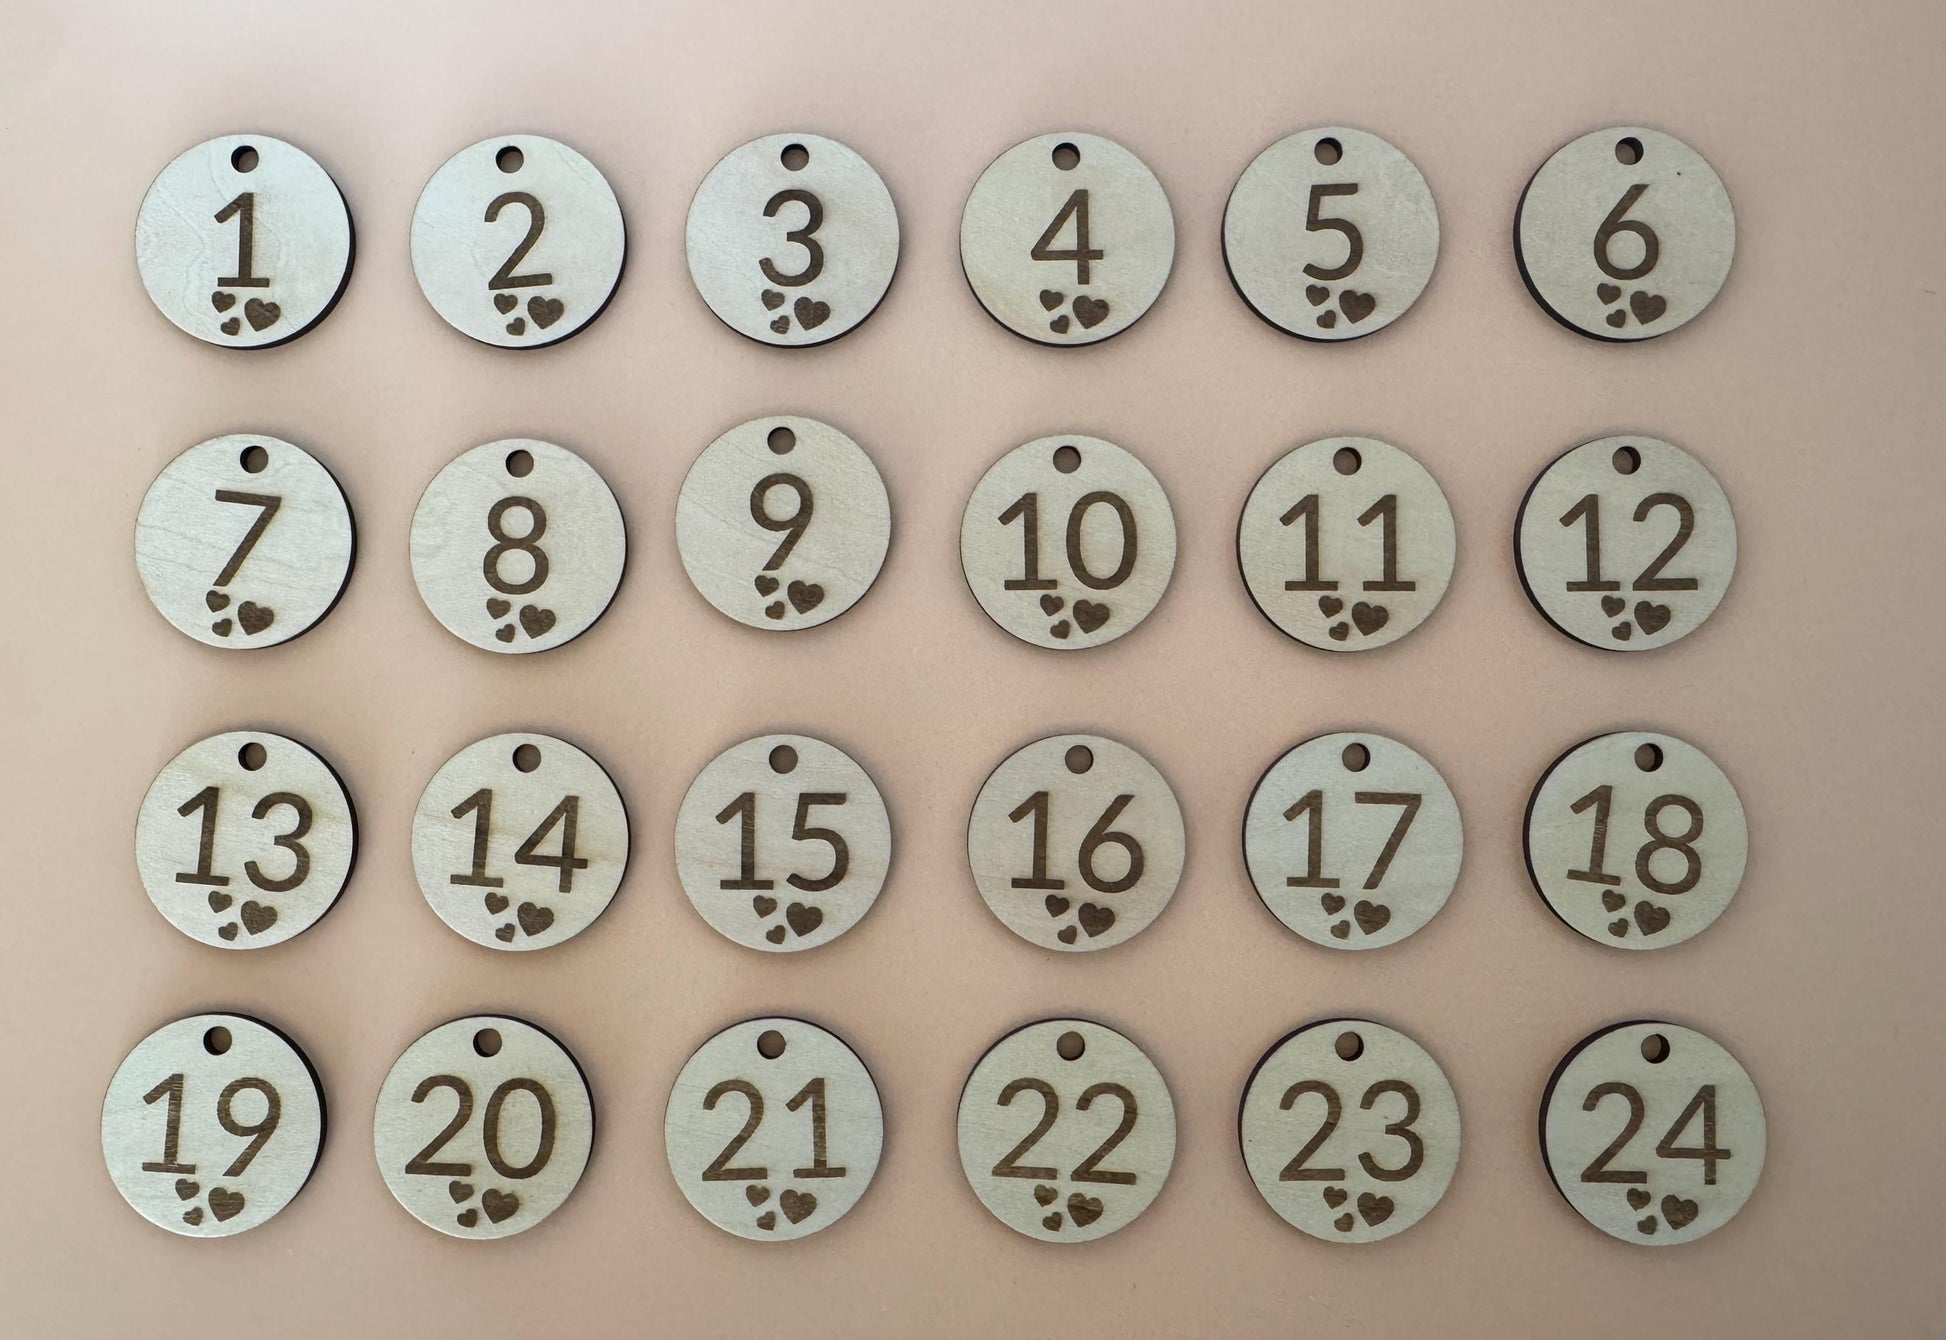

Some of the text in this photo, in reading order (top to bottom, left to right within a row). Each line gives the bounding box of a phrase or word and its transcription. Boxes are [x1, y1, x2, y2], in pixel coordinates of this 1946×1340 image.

[214, 192, 270, 288] 1
[485, 192, 553, 290] 2
[759, 189, 825, 287] 3
[1031, 189, 1104, 285] 4
[1303, 183, 1364, 281] 5
[1594, 184, 1661, 280] 6
[213, 489, 282, 587] 7
[483, 496, 549, 595] 8
[750, 472, 814, 571] 9
[998, 491, 1138, 590] 10
[1279, 494, 1416, 592] 11
[1559, 492, 1698, 592] 12
[176, 786, 314, 892] 13
[450, 788, 591, 893] 14
[715, 792, 850, 892] 15
[1008, 791, 1146, 893] 16
[1283, 790, 1422, 890] 17
[1567, 785, 1704, 895] 18
[142, 1074, 281, 1177] 19
[405, 1075, 558, 1179] 20
[702, 1078, 846, 1181] 21
[992, 1078, 1139, 1185] 22
[1279, 1079, 1426, 1182] 23
[1581, 1082, 1732, 1185] 24
